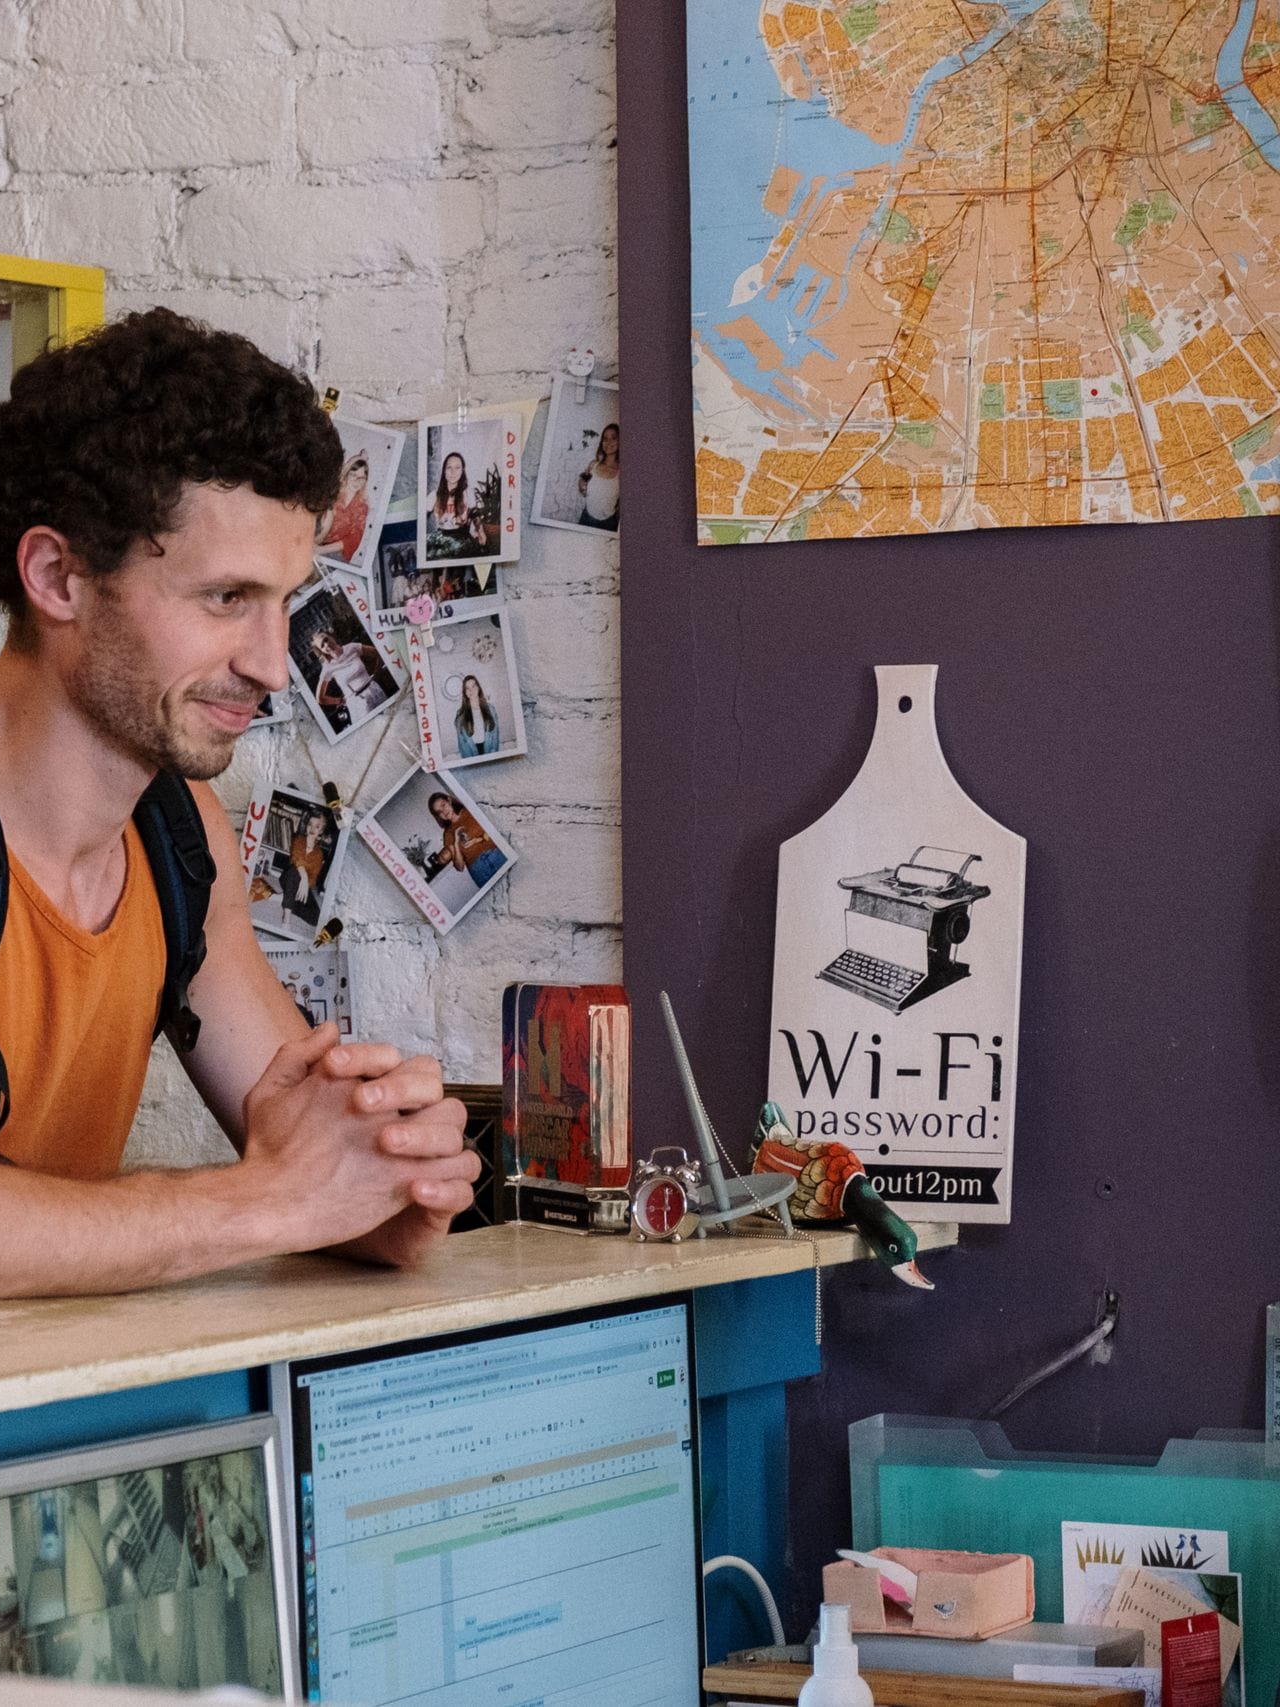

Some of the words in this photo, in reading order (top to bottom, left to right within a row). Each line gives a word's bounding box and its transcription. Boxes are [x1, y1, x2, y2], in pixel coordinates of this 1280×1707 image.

[242, 801, 266, 875] ULY
[777, 1029, 1003, 1102] Wi-Fi
[794, 1105, 1000, 1140] password:
[865, 1171, 983, 1201] out12pm
